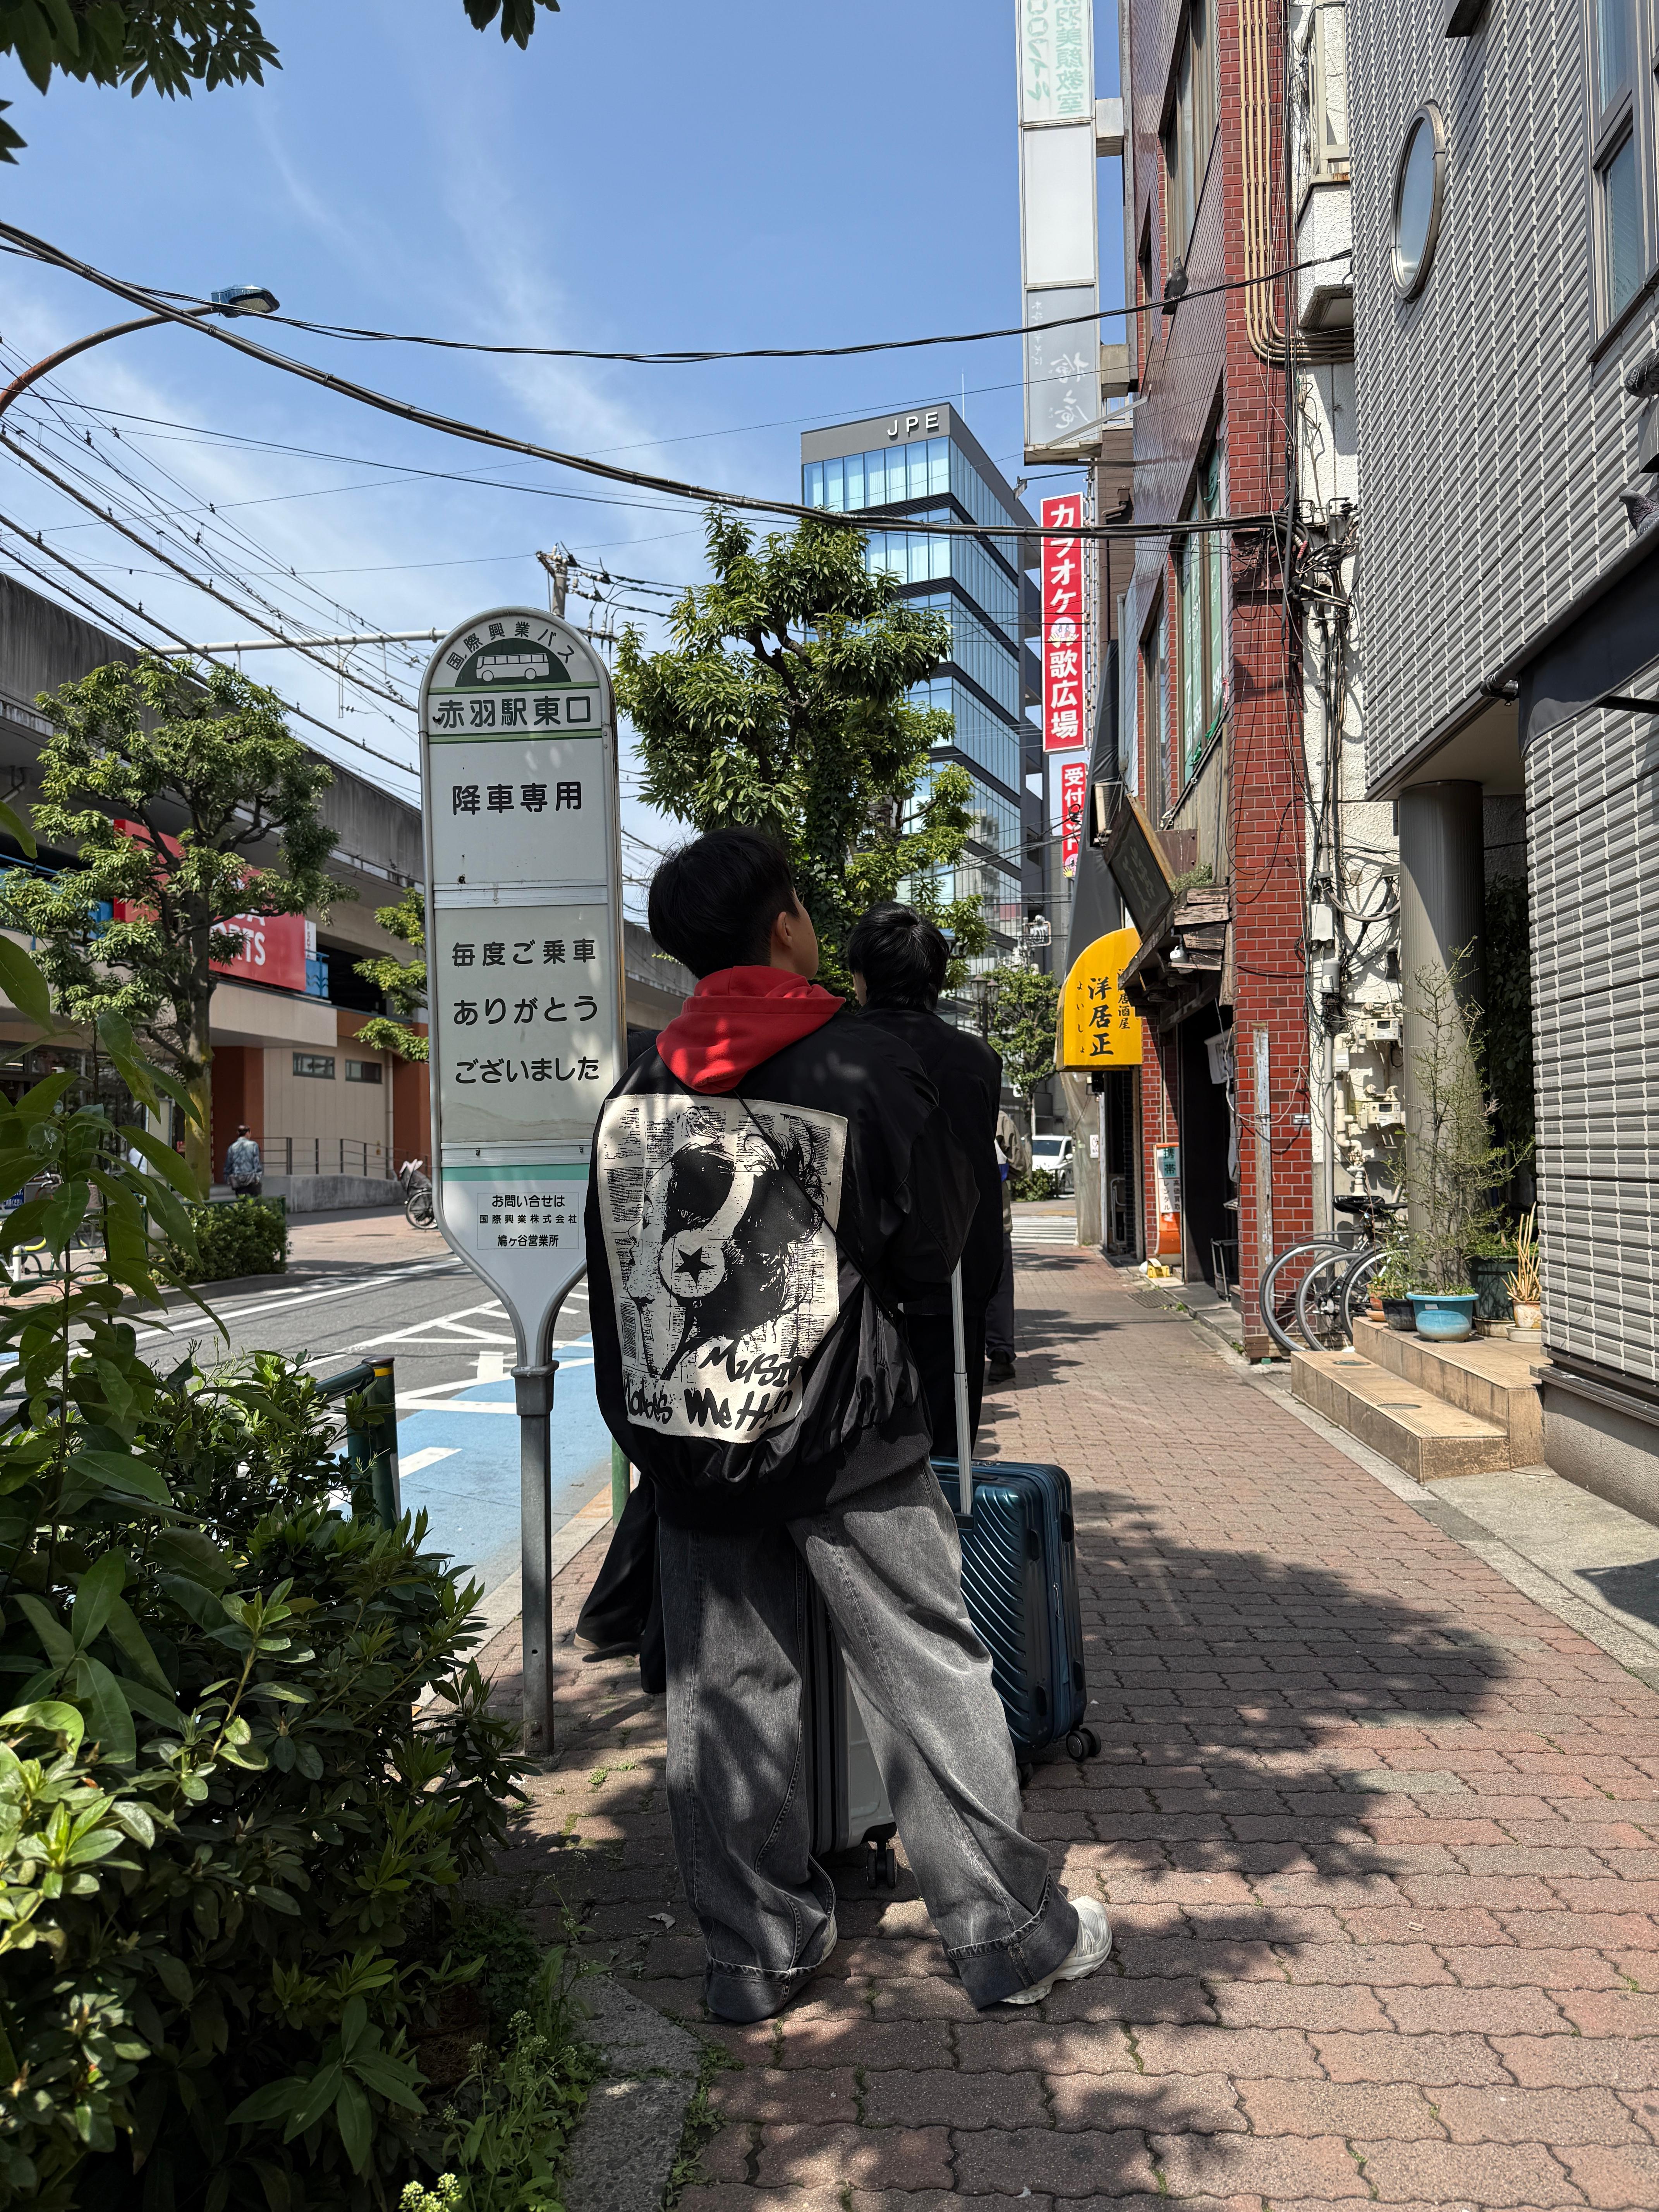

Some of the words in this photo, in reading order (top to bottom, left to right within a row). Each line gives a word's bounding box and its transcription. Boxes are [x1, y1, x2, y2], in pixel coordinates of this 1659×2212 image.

[887, 411, 939, 436] JPE
[446, 621, 575, 671] 国際興業バス
[1049, 651, 1079, 739] 歌広場
[438, 696, 591, 728] 赤羽駅東口
[452, 781, 582, 815] 降車専用
[452, 938, 596, 967] 毎度ご乗車
[453, 995, 597, 1025] ありがとう
[1077, 981, 1085, 1053] よいしょ
[1088, 976, 1114, 1056] 洋居正
[455, 1056, 599, 1084] ございました
[492, 1194, 565, 1208] お問い合せは
[479, 1214, 577, 1224] 国際興業株式会社
[684, 1388, 733, 1429] Me
